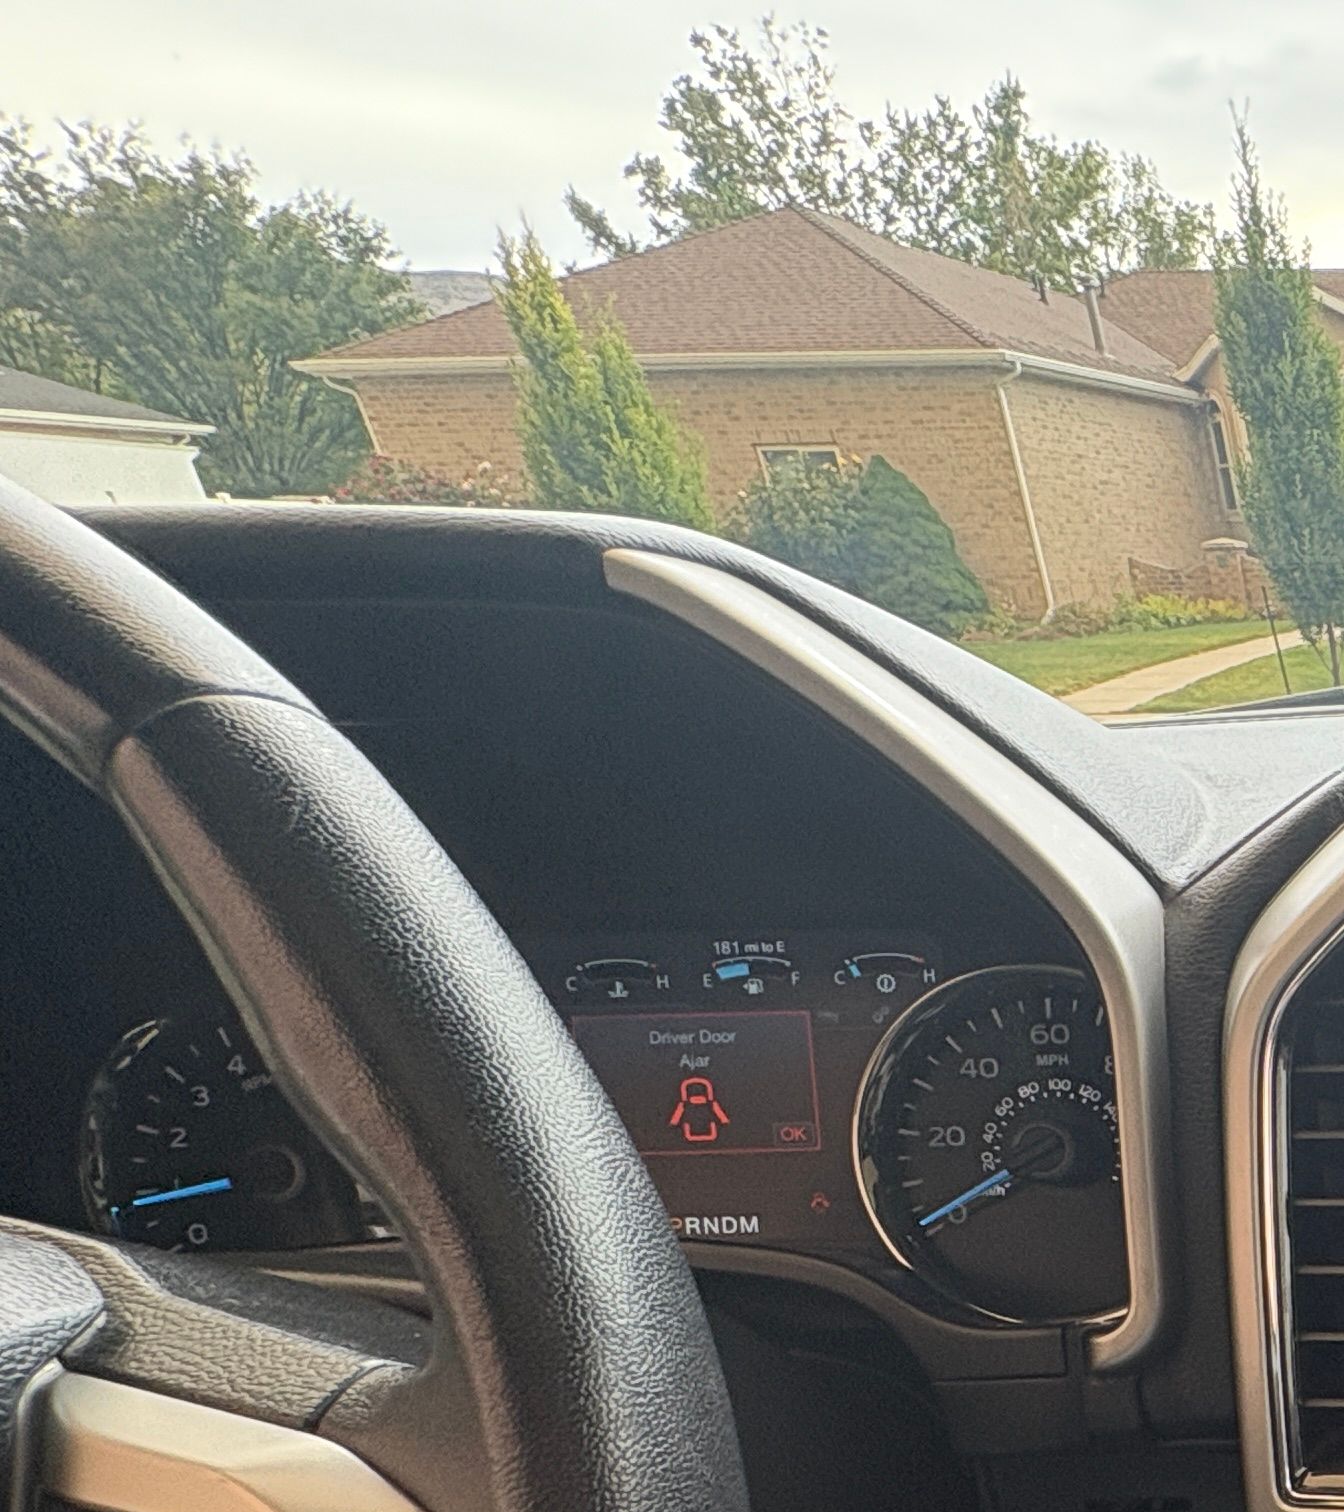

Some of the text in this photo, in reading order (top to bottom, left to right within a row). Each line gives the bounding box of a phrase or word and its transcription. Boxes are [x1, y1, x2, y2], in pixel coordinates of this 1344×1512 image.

[713, 941, 785, 955] 181 mi to E
[656, 975, 670, 989] H
[702, 973, 713, 988] E
[791, 971, 800, 986] F
[834, 971, 846, 985] C
[924, 969, 936, 983] H
[566, 977, 577, 992] C
[650, 1030, 737, 1045] Driver Door
[1030, 1023, 1070, 1044] 60
[226, 1055, 247, 1076] 4
[679, 1054, 710, 1070] Ajar
[960, 1057, 999, 1078] 40
[1036, 1054, 1069, 1066] MPH
[1017, 1081, 1040, 1098] 80
[1049, 1078, 1071, 1091] 100
[1078, 1084, 1101, 1101] 120
[190, 1086, 210, 1107] 3
[994, 1097, 1014, 1117] 60
[169, 1127, 189, 1148] 2
[780, 1126, 807, 1141] OK
[928, 1125, 966, 1147] 20
[982, 1122, 997, 1144] 40
[981, 1151, 995, 1171] 20
[187, 1223, 209, 1245] 0
